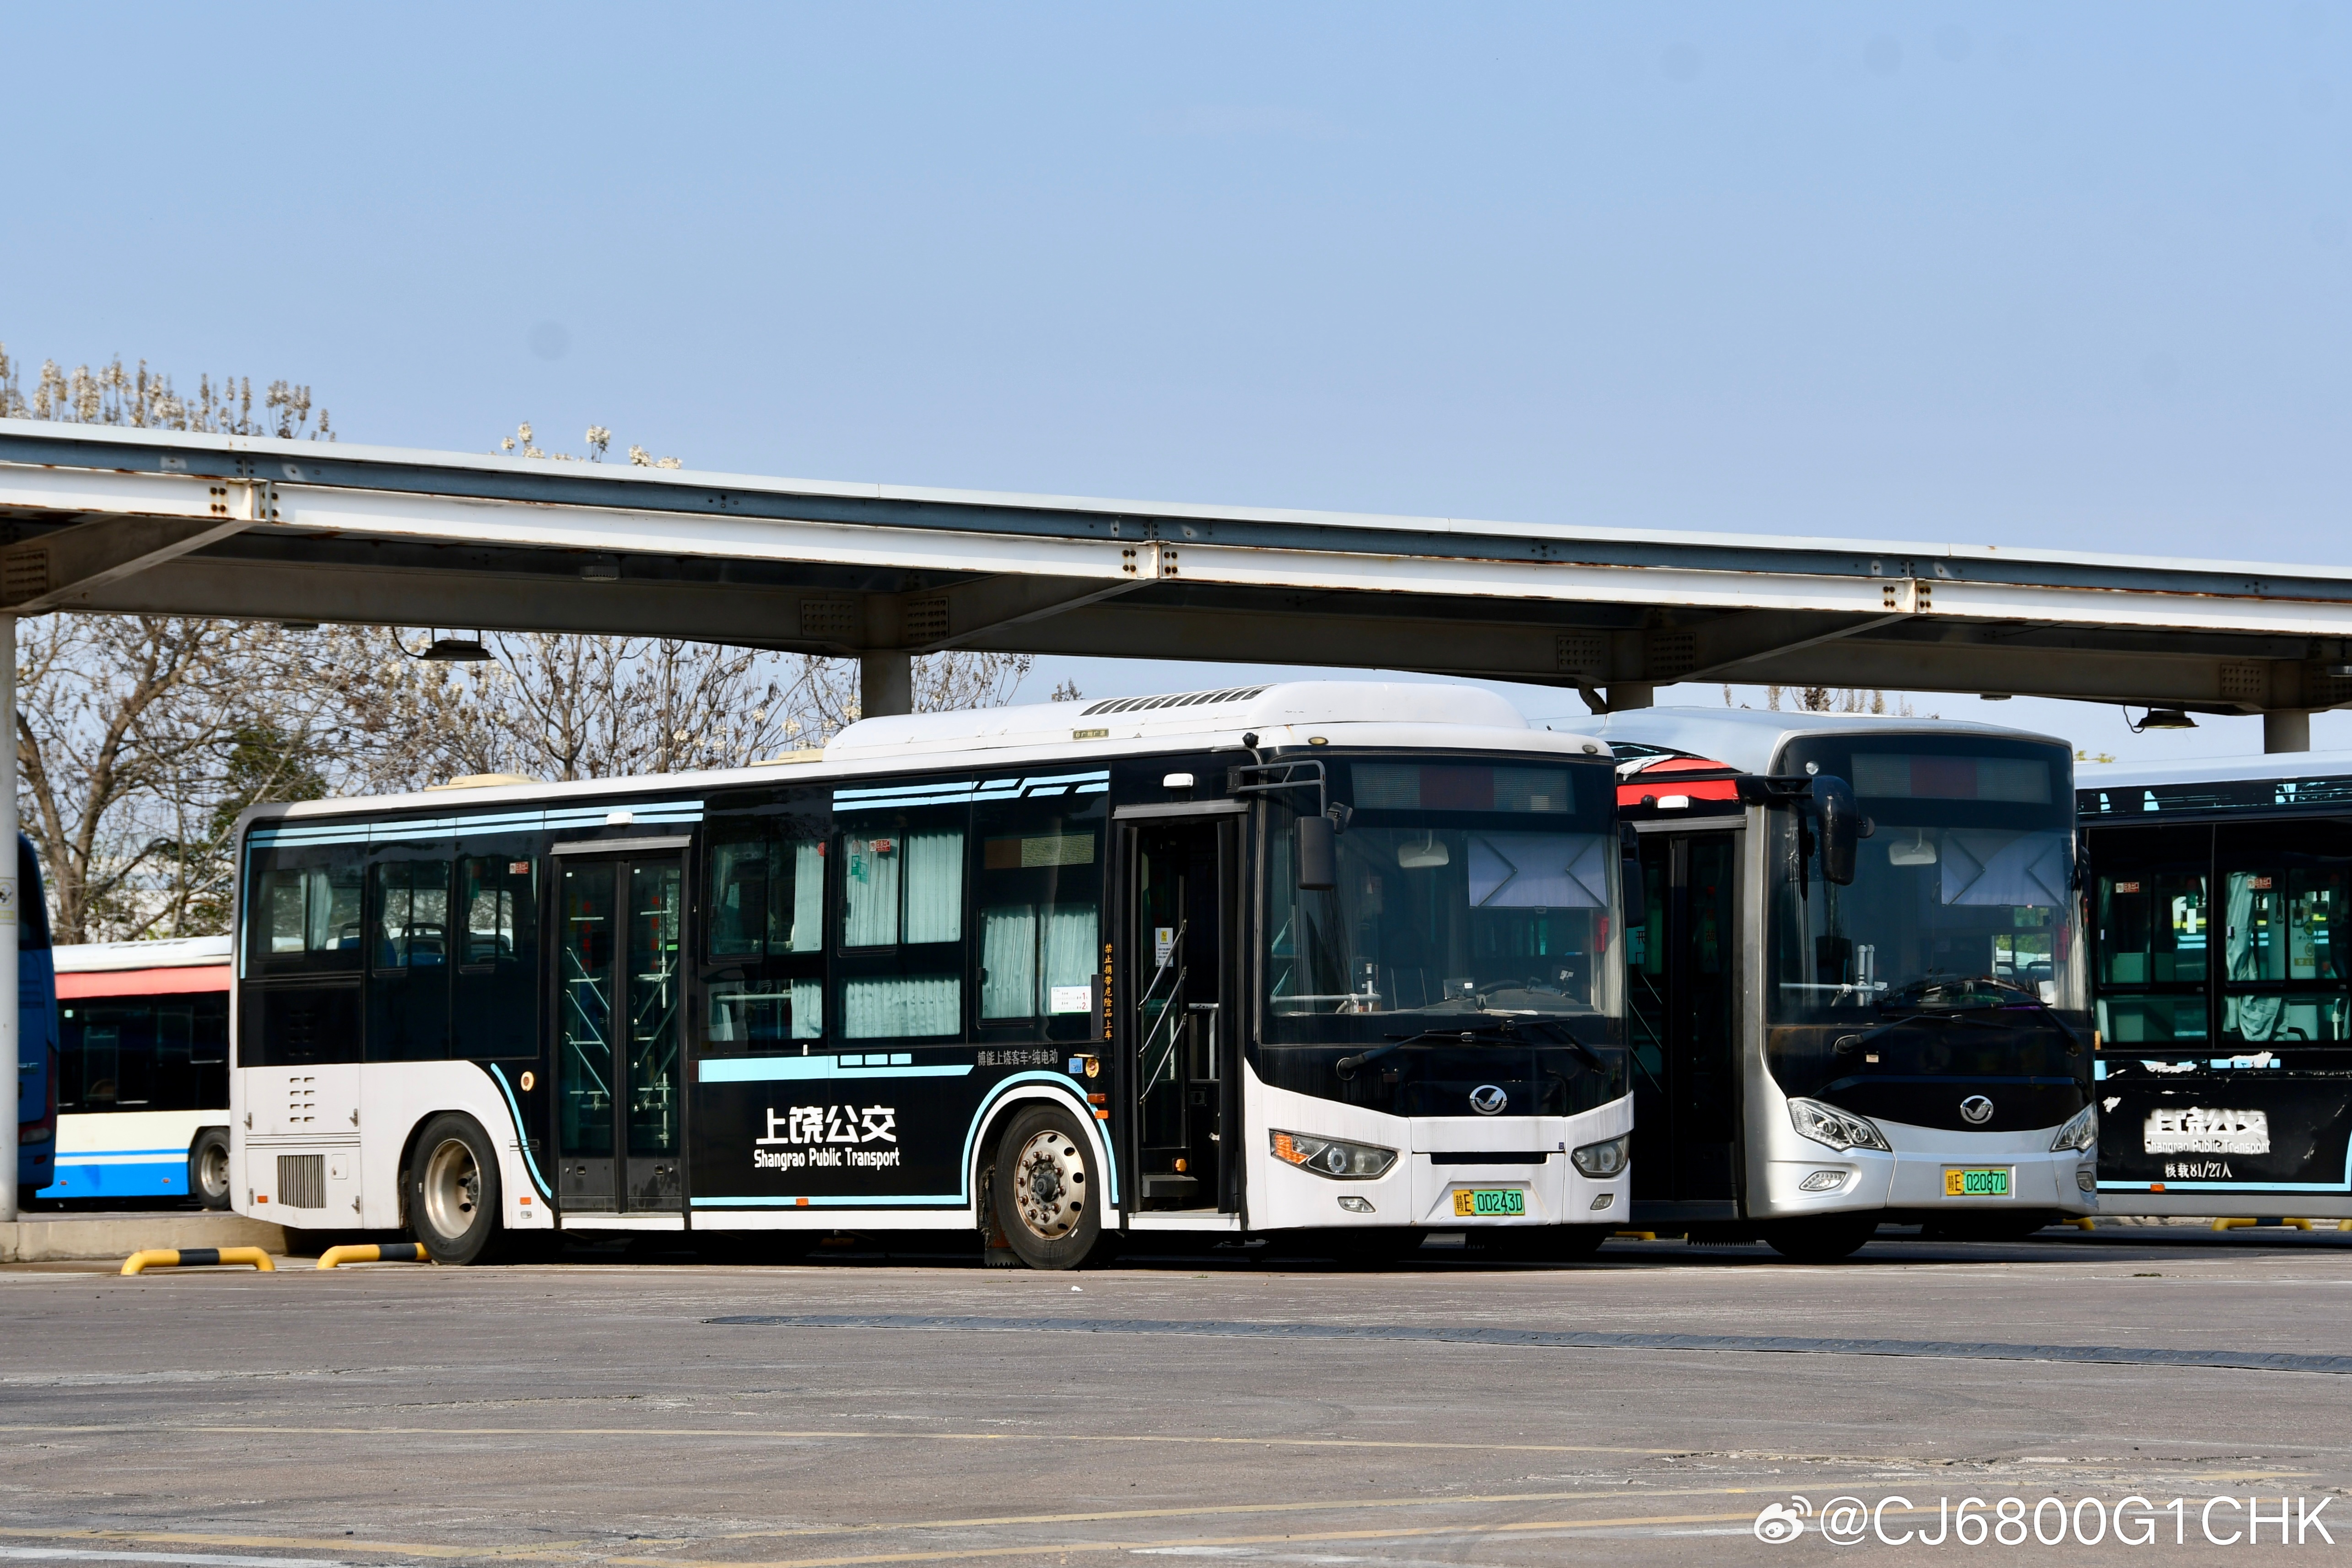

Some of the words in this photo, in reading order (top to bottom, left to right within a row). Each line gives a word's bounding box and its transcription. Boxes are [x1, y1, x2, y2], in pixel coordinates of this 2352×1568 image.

[1104, 943, 1113, 1040] 禁止携带危险品上车
[756, 1105, 896, 1144] 上饶公交
[2147, 1106, 2267, 1136] 上饶公交
[754, 1149, 805, 1171] Shangrao
[809, 1147, 842, 1166] Public
[845, 1147, 900, 1170] Transport
[2193, 1139, 2221, 1153] Public
[2223, 1139, 2271, 1154] Transport
[2165, 1161, 2233, 1178] 核载81/27人
